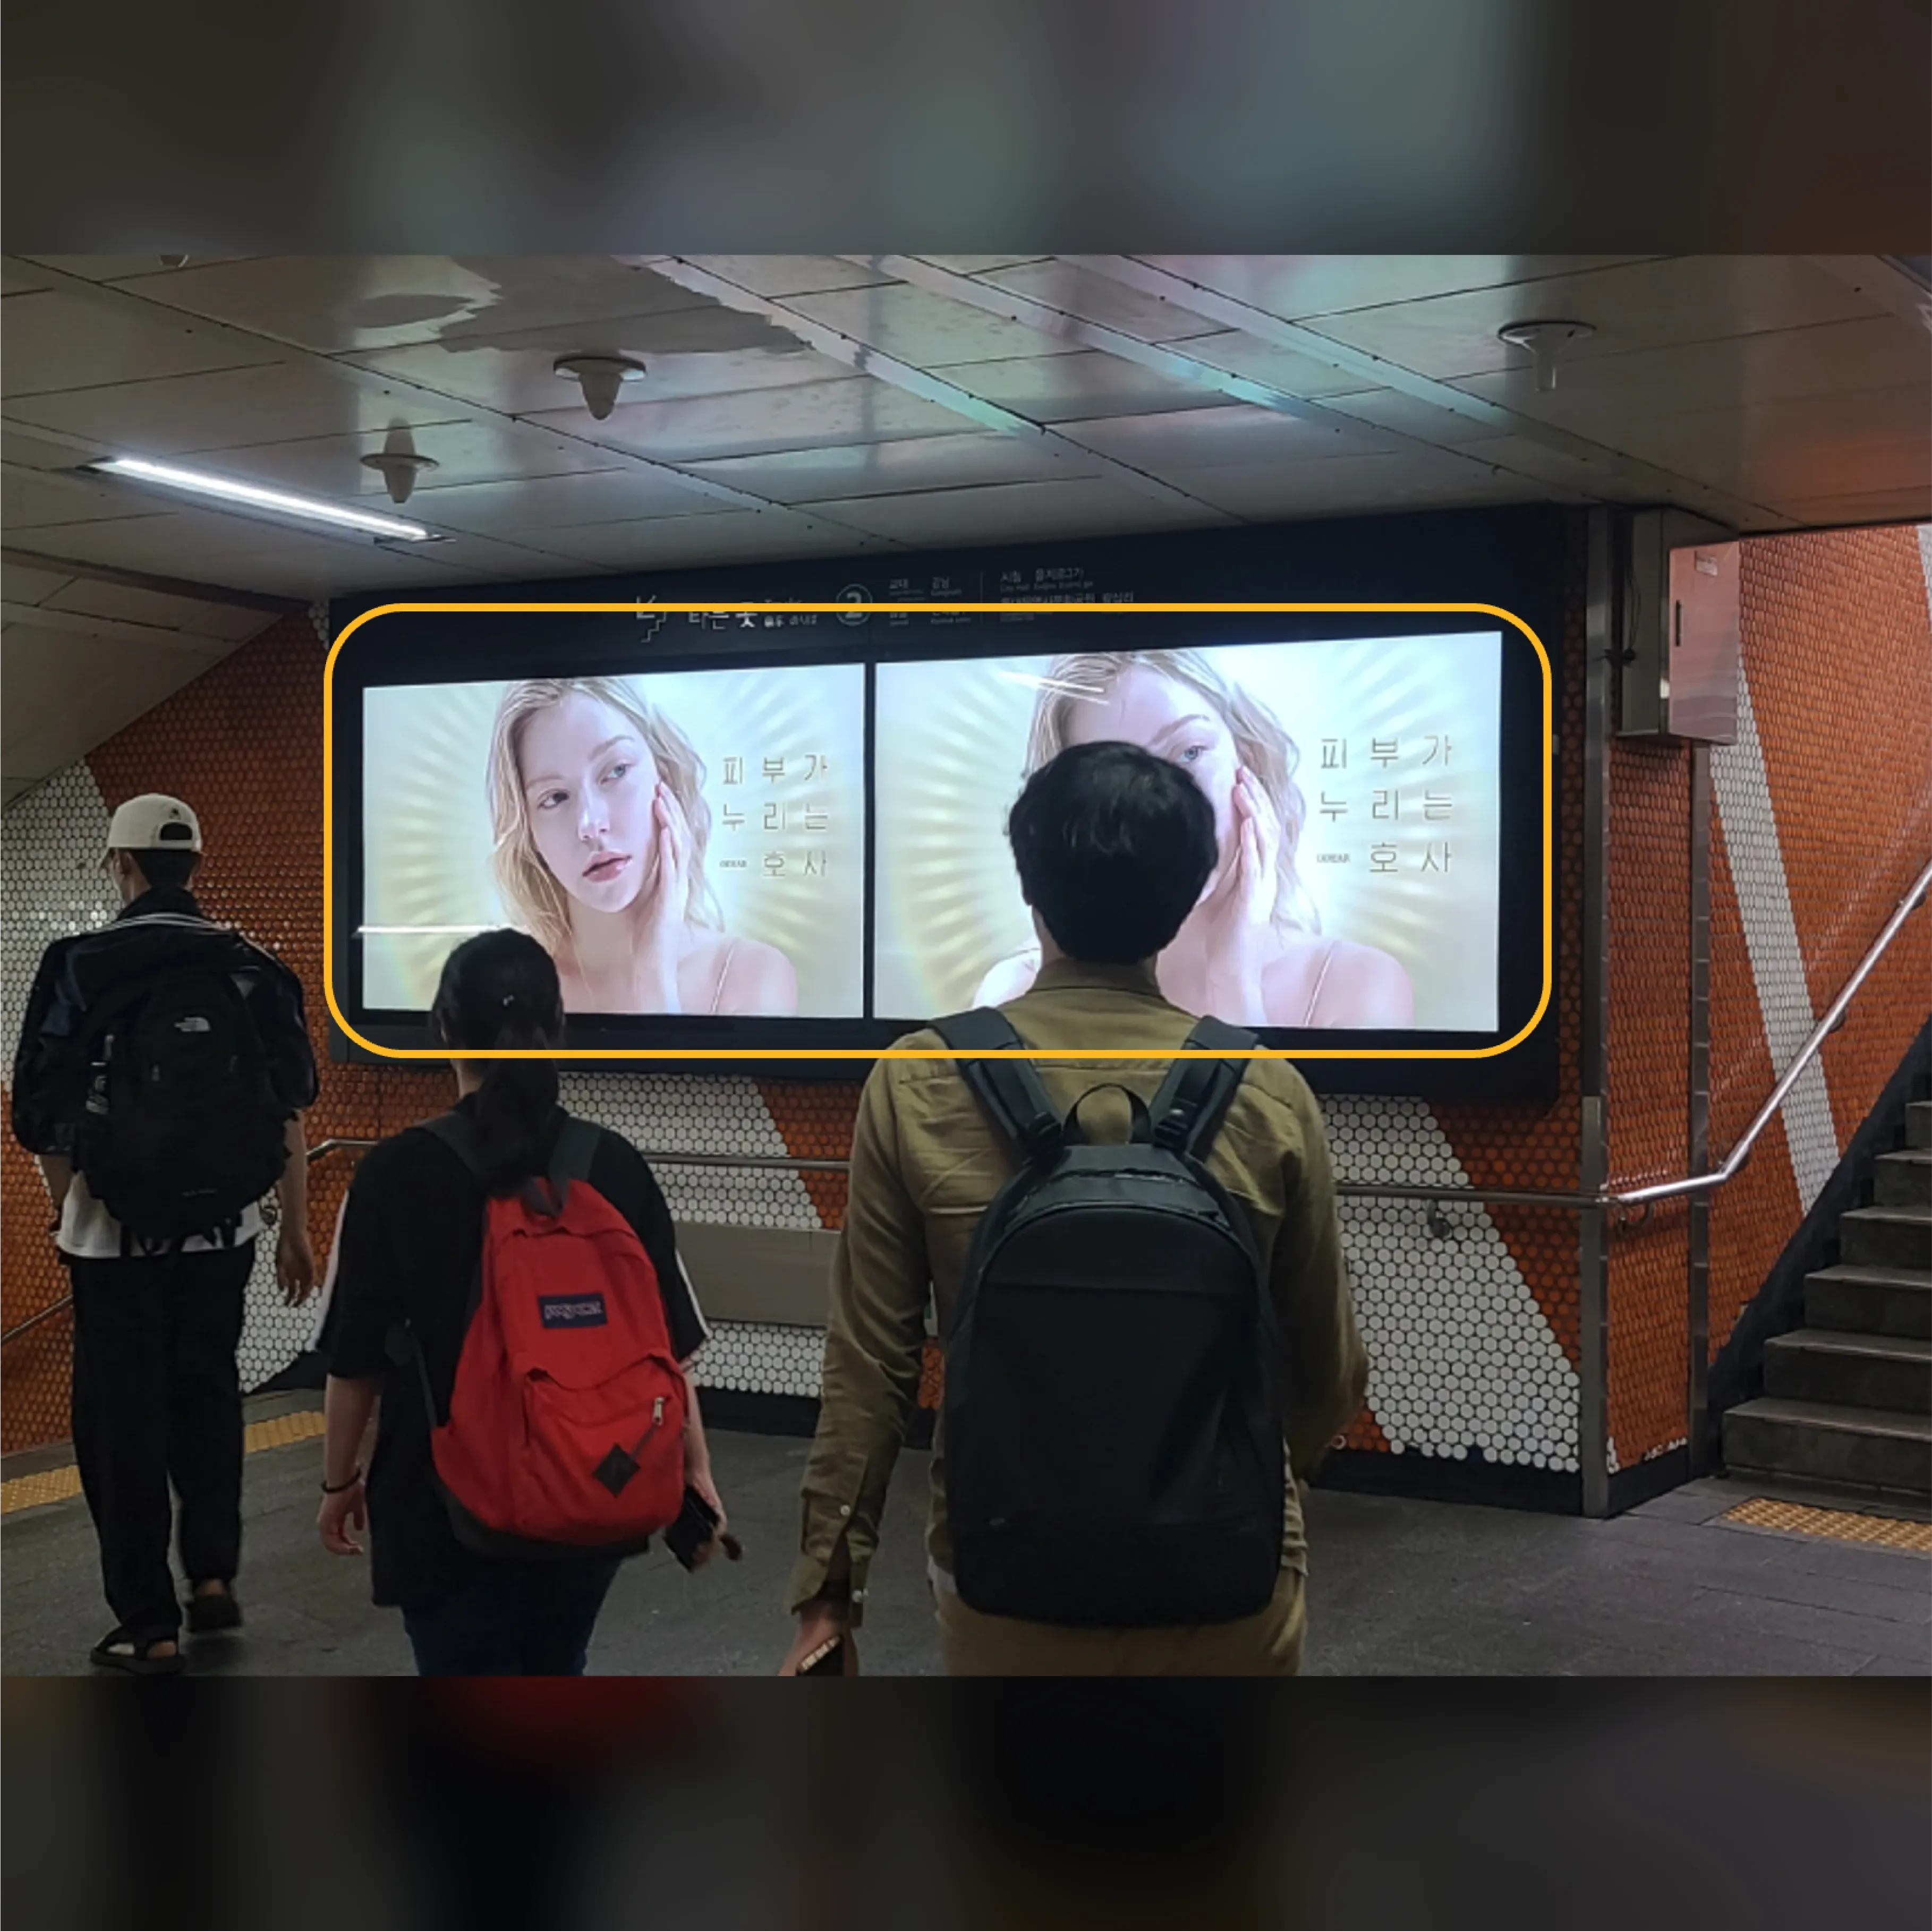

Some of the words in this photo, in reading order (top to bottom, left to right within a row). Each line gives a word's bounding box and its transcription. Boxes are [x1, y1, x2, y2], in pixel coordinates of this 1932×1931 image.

[1320, 734, 1453, 769] 피부가
[722, 753, 828, 784] 피부가
[721, 801, 829, 832] 누리는
[1319, 789, 1453, 823] 누리는
[762, 849, 827, 877] 호사
[1369, 841, 1453, 873] 호사
